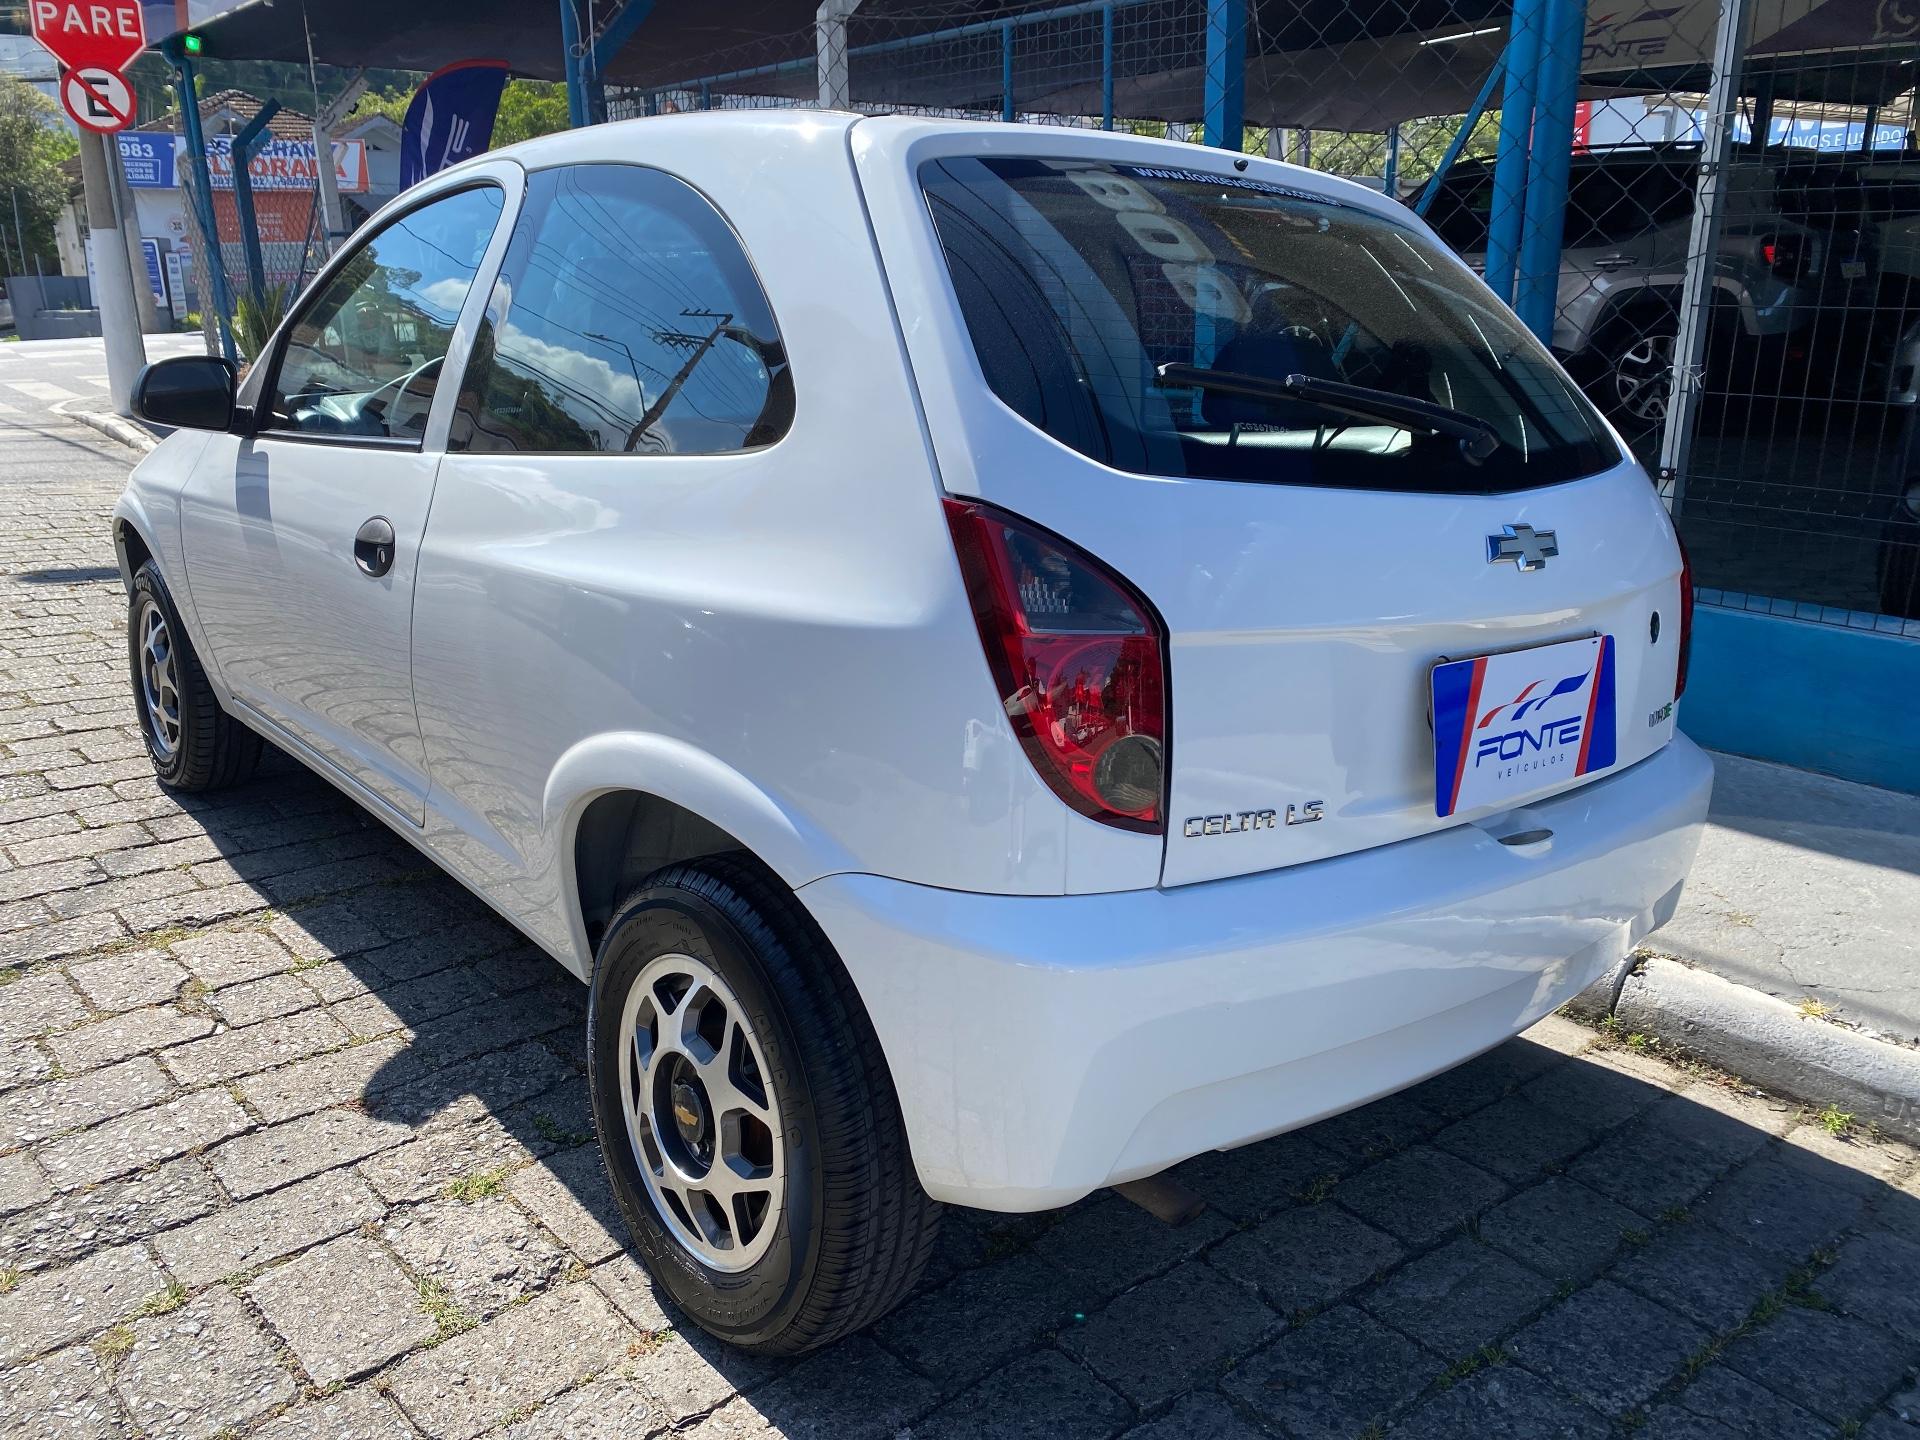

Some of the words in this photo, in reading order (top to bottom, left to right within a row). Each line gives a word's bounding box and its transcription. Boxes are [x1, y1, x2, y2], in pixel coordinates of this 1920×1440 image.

[36, 1, 139, 37] PARE
[1582, 36, 1668, 60] ONTE
[119, 142, 154, 157] 983
[1476, 715, 1582, 768] FONTE
[1498, 753, 1565, 779] VEÍCULOS
[1184, 808, 1277, 838] CELTA
[1286, 800, 1324, 826] LS
